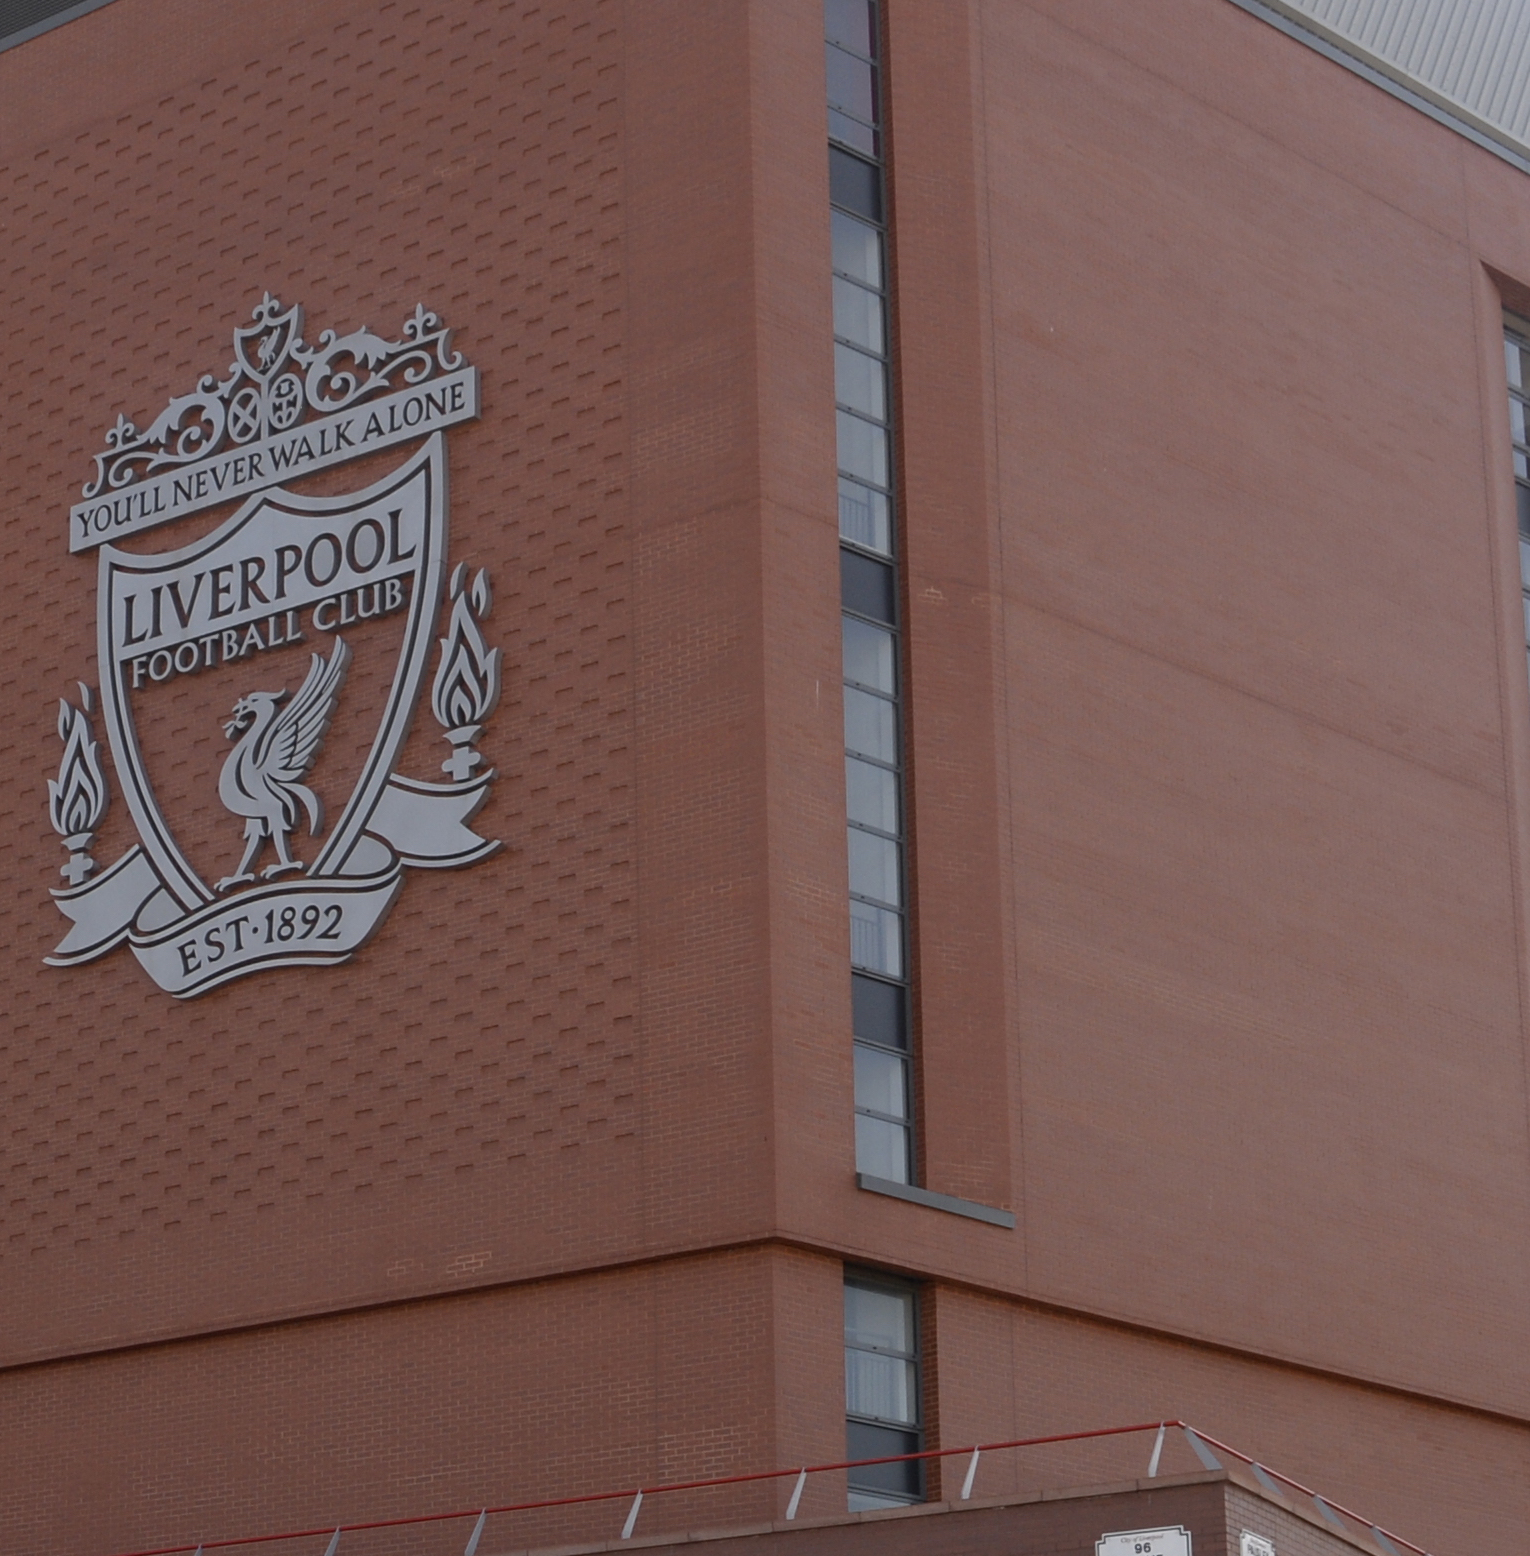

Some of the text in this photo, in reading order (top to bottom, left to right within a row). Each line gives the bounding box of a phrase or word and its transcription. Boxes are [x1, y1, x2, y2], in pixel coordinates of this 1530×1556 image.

[77, 382, 467, 538] YOU'LL NEVER WALK ALONE
[122, 508, 416, 647] LIVERPOOL
[132, 578, 403, 689] FOOTBALL CLUB
[1134, 1542, 1152, 1554] 96
